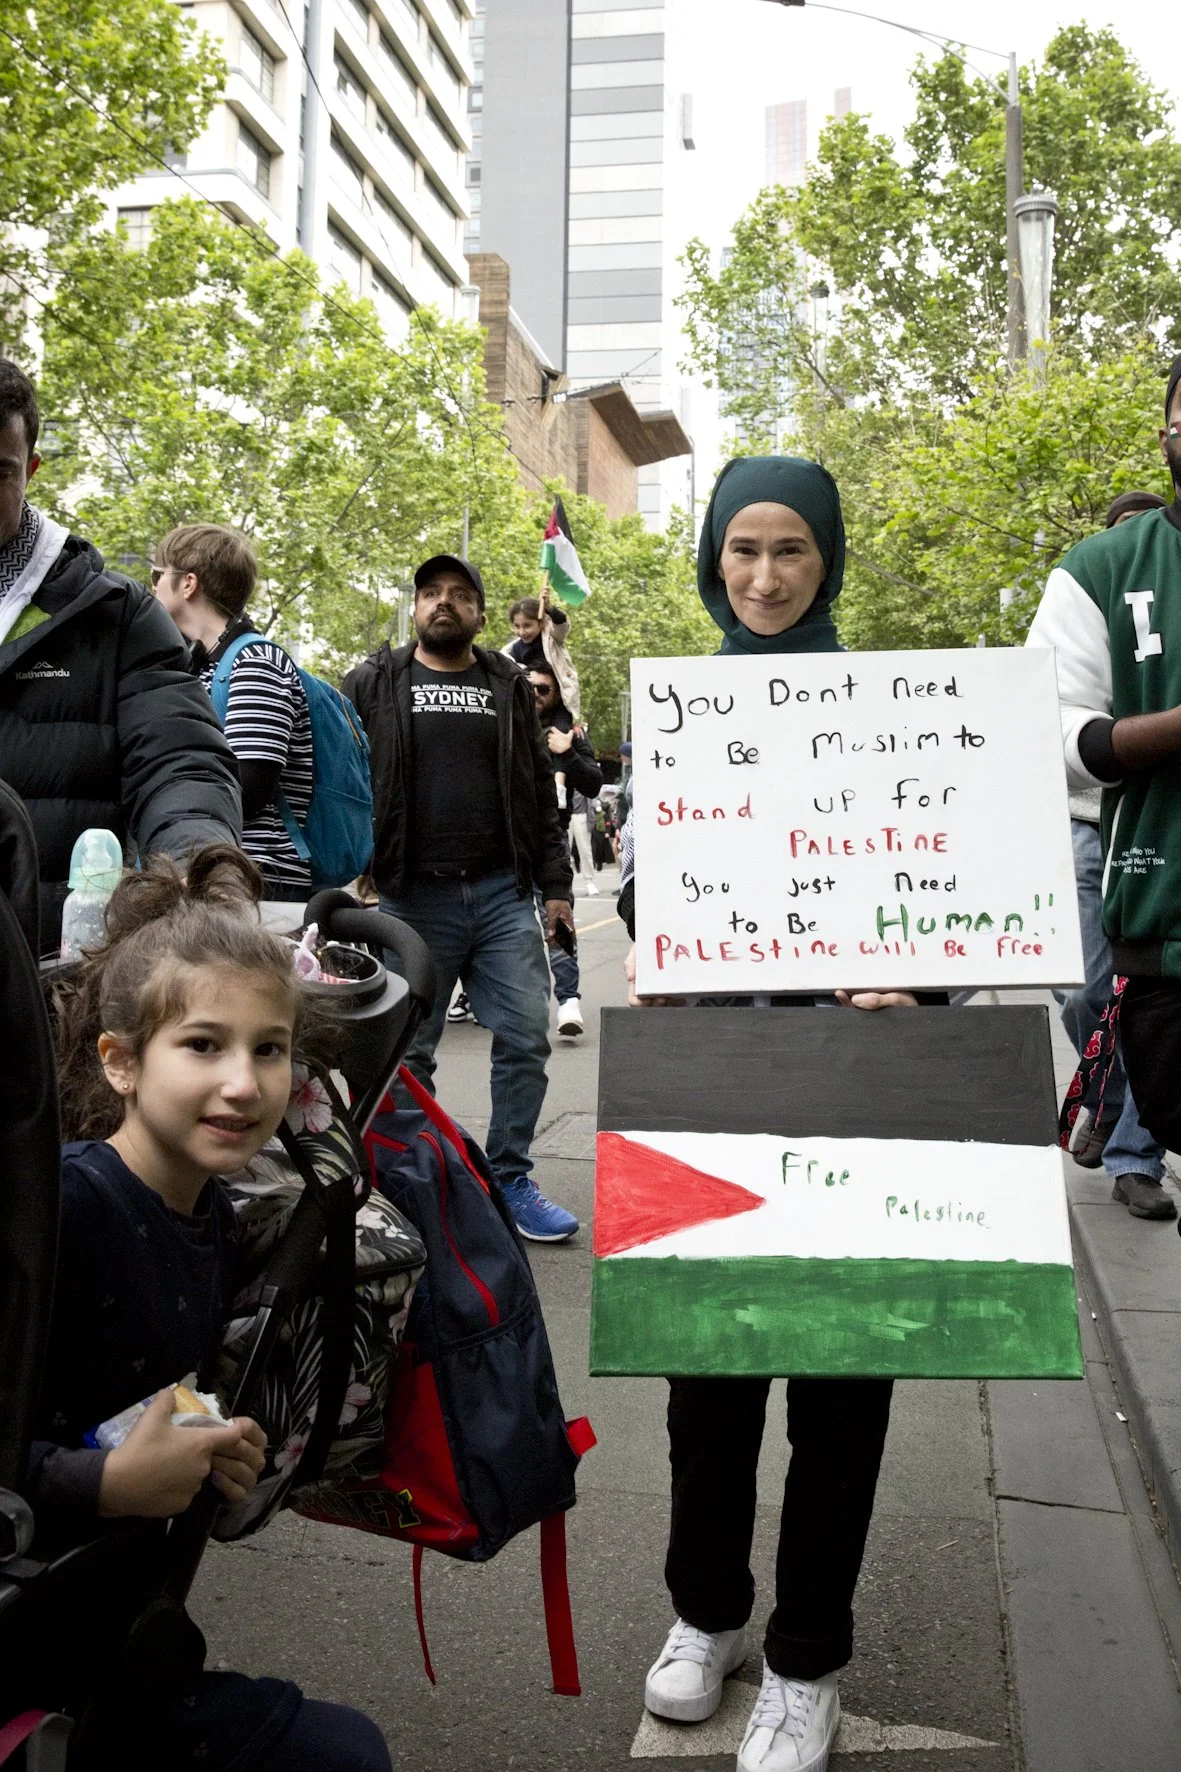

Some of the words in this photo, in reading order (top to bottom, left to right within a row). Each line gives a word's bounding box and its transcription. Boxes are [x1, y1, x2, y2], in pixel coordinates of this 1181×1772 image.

[15, 669, 70, 679] Kathmandu
[413, 691, 488, 707] SYDNEY
[768, 674, 858, 707] Dont
[651, 750, 676, 768] to
[727, 740, 760, 766] Be
[953, 724, 986, 749] to
[728, 910, 759, 935] to
[786, 912, 819, 935] Be
[943, 939, 968, 958] Be
[781, 1151, 850, 1187] Free
[885, 1195, 986, 1227] Palestine
